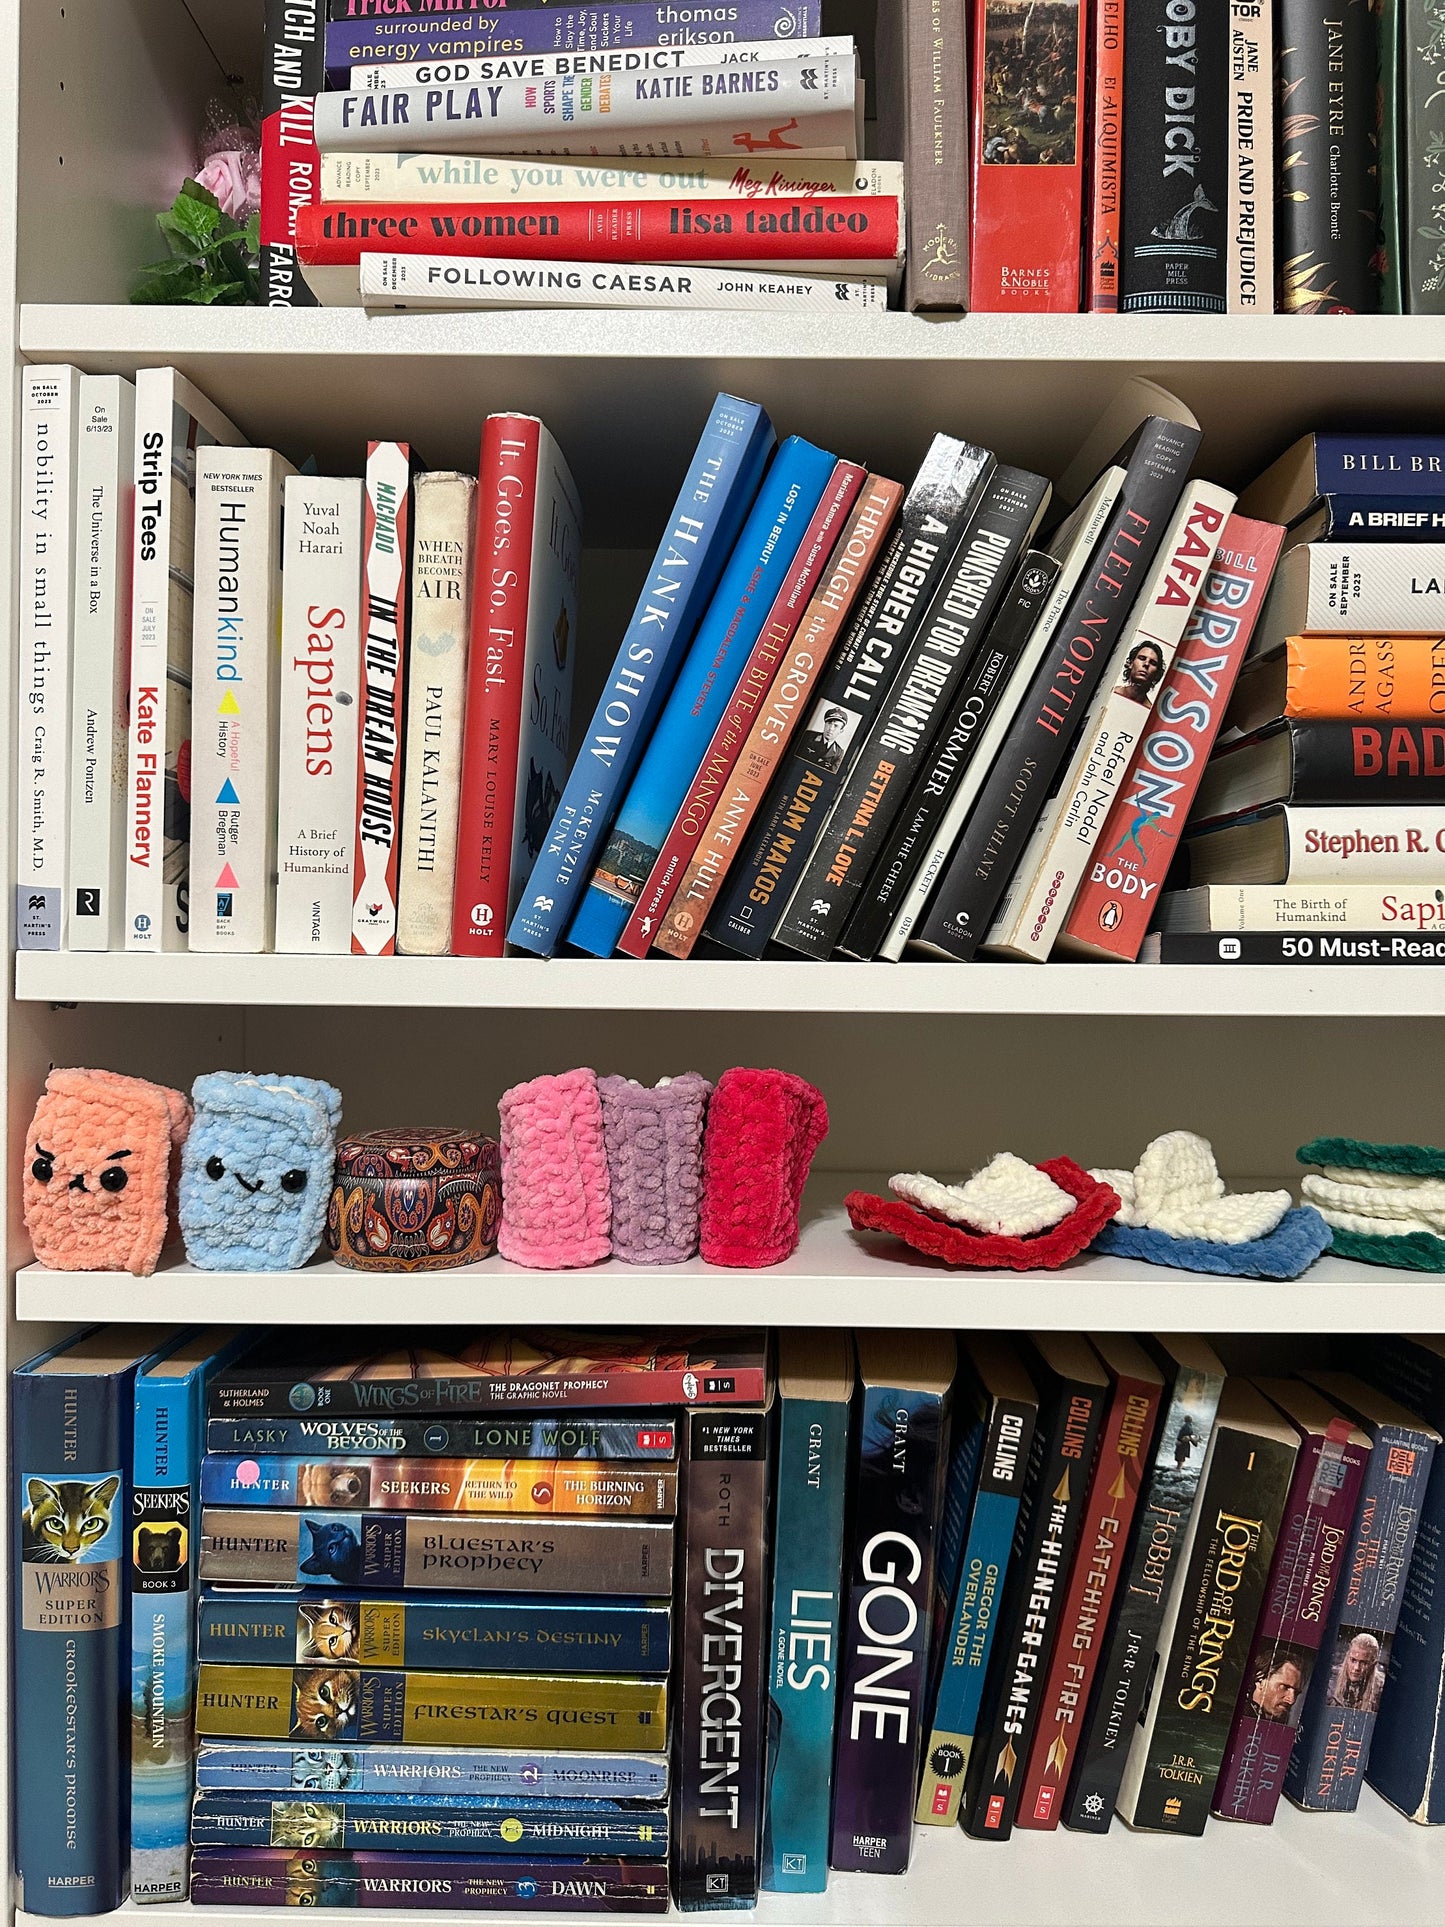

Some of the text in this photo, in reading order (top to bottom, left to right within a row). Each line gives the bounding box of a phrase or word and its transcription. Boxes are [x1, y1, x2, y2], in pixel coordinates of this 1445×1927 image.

[376, 17, 498, 35] surrounded by
[656, 6, 737, 23] thomas
[350, 38, 523, 60] energy vampires
[658, 28, 734, 46] erikson
[1324, 18, 1344, 73] JANE
[416, 51, 685, 84] GOD SAVE BENEDICT
[1232, 29, 1244, 81] AUSTEN
[1246, 39, 1258, 73] JANE
[525, 86, 537, 108] HOW
[544, 81, 556, 114] SPORTS
[581, 78, 592, 111] GENDER
[636, 70, 779, 99] KATIE BARNES
[343, 86, 503, 127] FAIR PLAY
[1328, 81, 1344, 136] EYRE
[1163, 86, 1200, 178] DICK
[1101, 89, 1119, 215] ALQUIMISTA
[417, 160, 708, 193] while you were out
[729, 167, 836, 198] Meg Kissinger
[1329, 145, 1341, 199] Charlotte
[1235, 91, 1255, 307] PRIDE AND PREJUDICE
[324, 212, 560, 238] three women
[670, 206, 868, 234] lisa taddeo
[428, 267, 812, 295] FOLLOWING CAESAR JOHN KEAHEY
[1167, 270, 1187, 278] MILL
[93, 486, 103, 509] The
[138, 433, 163, 561] Strip Tees
[304, 503, 340, 516] Yuval
[91, 512, 103, 563] Universe
[303, 522, 339, 535] Noah
[299, 540, 342, 554] Harari
[418, 554, 462, 565] BREATH
[419, 541, 463, 553] WHEN
[1155, 502, 1224, 608] RAFA
[91, 566, 100, 577] in
[418, 567, 462, 576] BECOMES
[484, 439, 526, 693] It. Goes. So. Fast.
[217, 502, 246, 681] Humankind
[418, 580, 462, 600] AIR
[1341, 556, 1350, 615] SEPTEMBER
[90, 591, 101, 614] Box
[590, 457, 723, 768] THE HANK SHOW
[1036, 508, 1150, 737] FLEE NORTH
[29, 423, 54, 871] nobility in small things Craig R. Smith, M.D.
[879, 529, 1011, 756] PUNISHED FOR DREAMING
[294, 605, 345, 776] Sapiens
[1123, 572, 1256, 819] BRYSON
[362, 594, 398, 848] IN THE DREAM HOUSE
[86, 709, 97, 803] Andrew Pontzen
[924, 695, 984, 796] CORMIER
[131, 687, 158, 867] Kate Flannery
[418, 686, 442, 872] PAUL KALANITHI
[1076, 731, 1133, 845] Rafael Nadal
[480, 719, 500, 883] MARY LOUISE KELLY
[216, 811, 227, 856] Bregman
[229, 811, 240, 844] Rutger
[1305, 829, 1398, 858] Stephen
[284, 863, 348, 874] Humankind
[1090, 862, 1157, 900] BODY
[1118, 857, 1139, 872] THE
[1274, 899, 1347, 909] The Birth of
[1276, 912, 1346, 922] Humankind
[312, 901, 320, 942] VINTAGE
[1282, 939, 1313, 956] 50
[510, 1380, 608, 1391] DRAGONET PROPHECY
[64, 1389, 77, 1461] HUNTER
[156, 1407, 168, 1476] HUNTER
[300, 1422, 378, 1437] WOLVES
[475, 1430, 600, 1445] LONE WOLF
[328, 1437, 406, 1450] BEYOND
[807, 1424, 822, 1488] GRANT
[993, 1414, 1023, 1481] COLLINS
[381, 1481, 450, 1494] SEEKERS
[576, 1495, 632, 1506] HORIZON
[590, 1481, 644, 1492] BURNING
[133, 1492, 189, 1515] SEEKERS
[213, 1538, 287, 1553] HUNTER
[35, 1569, 110, 1594] WARRIORS
[1021, 1540, 1063, 1647] HUNGER
[39, 1613, 104, 1624] EDITION
[46, 1599, 96, 1610] SUPER
[1055, 1516, 1119, 1723] CATCHING FIRE
[787, 1589, 834, 1692] LIES
[850, 1531, 922, 1744] GONE
[1178, 1613, 1235, 1713] RINGS
[152, 1614, 165, 1748] SMOKE MOUNTAIN
[699, 1548, 744, 1829] DIVERGENT
[1004, 1653, 1038, 1734] GAMES
[1104, 1677, 1131, 1749] TOLKIEN
[1160, 1768, 1202, 1784] TOLKIEN
[853, 1836, 887, 1847] HARPER
[859, 1847, 880, 1858] TEEN
[48, 1876, 95, 1885] HARPER
[364, 1878, 451, 1892] WARRIORS
[551, 1881, 606, 1896] DAWN
